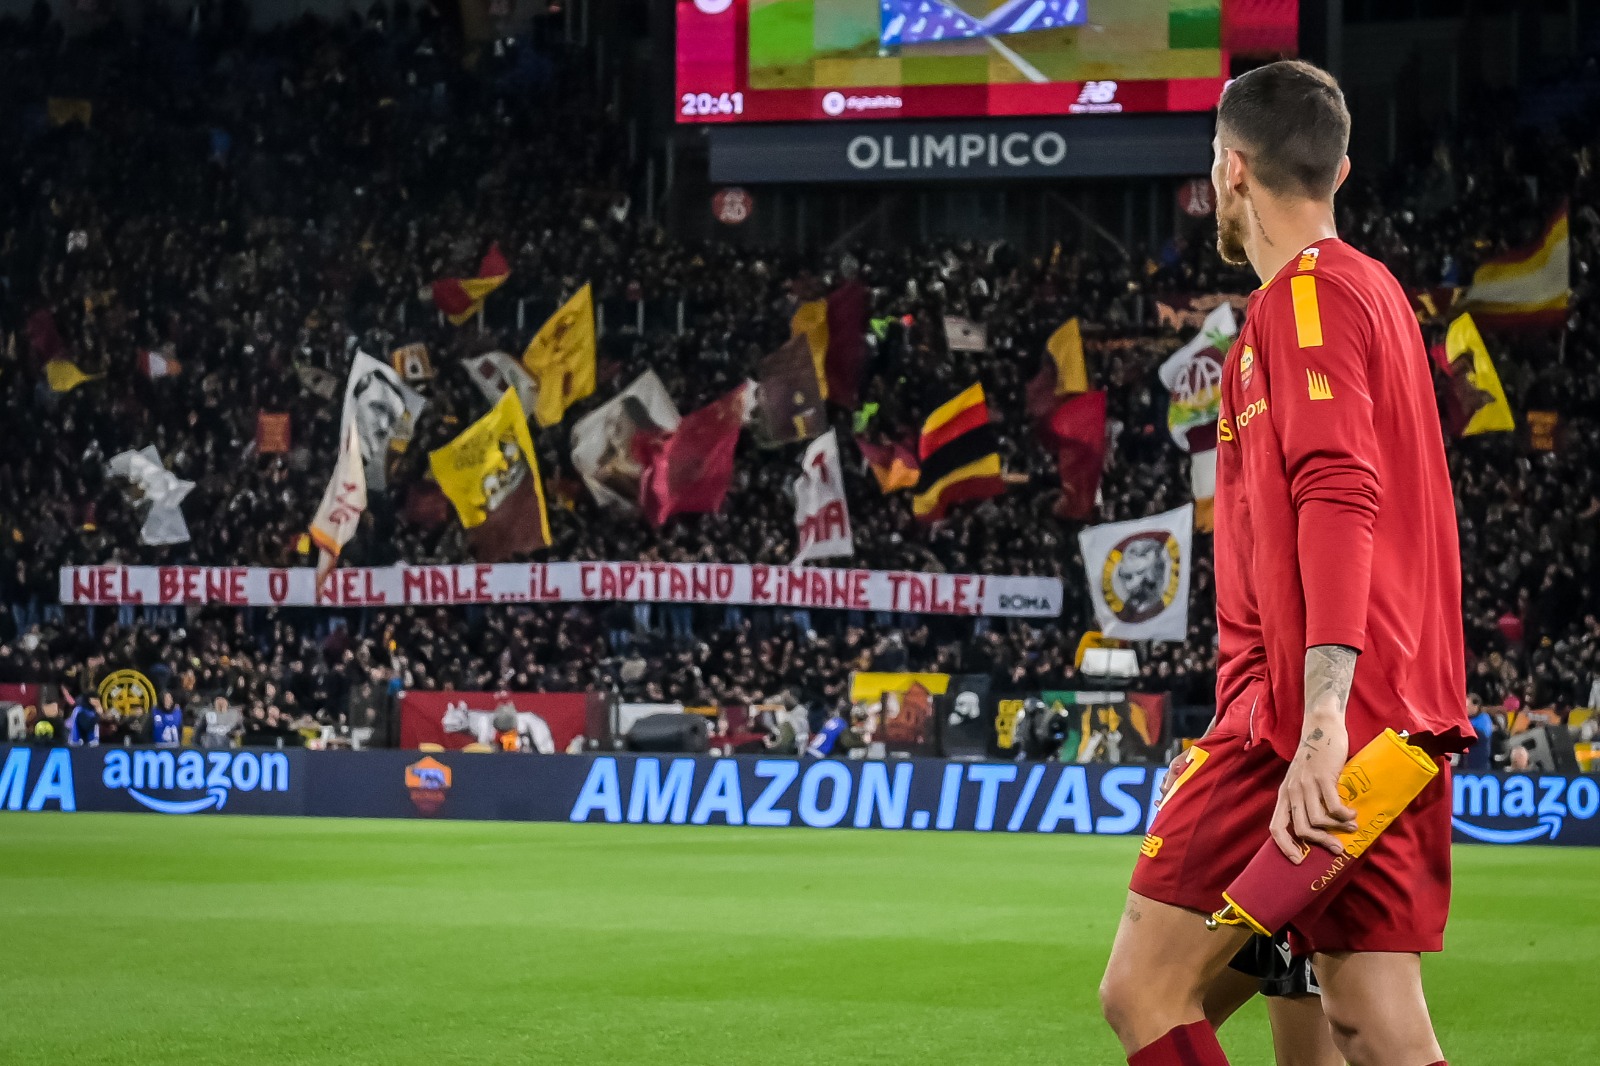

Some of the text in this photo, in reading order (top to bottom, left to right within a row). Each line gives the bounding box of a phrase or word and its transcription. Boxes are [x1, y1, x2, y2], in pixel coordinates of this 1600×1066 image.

[681, 92, 744, 116] 20:41
[847, 130, 1068, 169] OLIMPICO
[73, 565, 144, 605] NEL
[158, 565, 249, 606] BENE
[267, 567, 290, 605] O
[887, 572, 985, 616] TALE!
[998, 594, 1052, 611] ROMA
[102, 749, 290, 793] amazon
[1452, 773, 1600, 820] mazo
